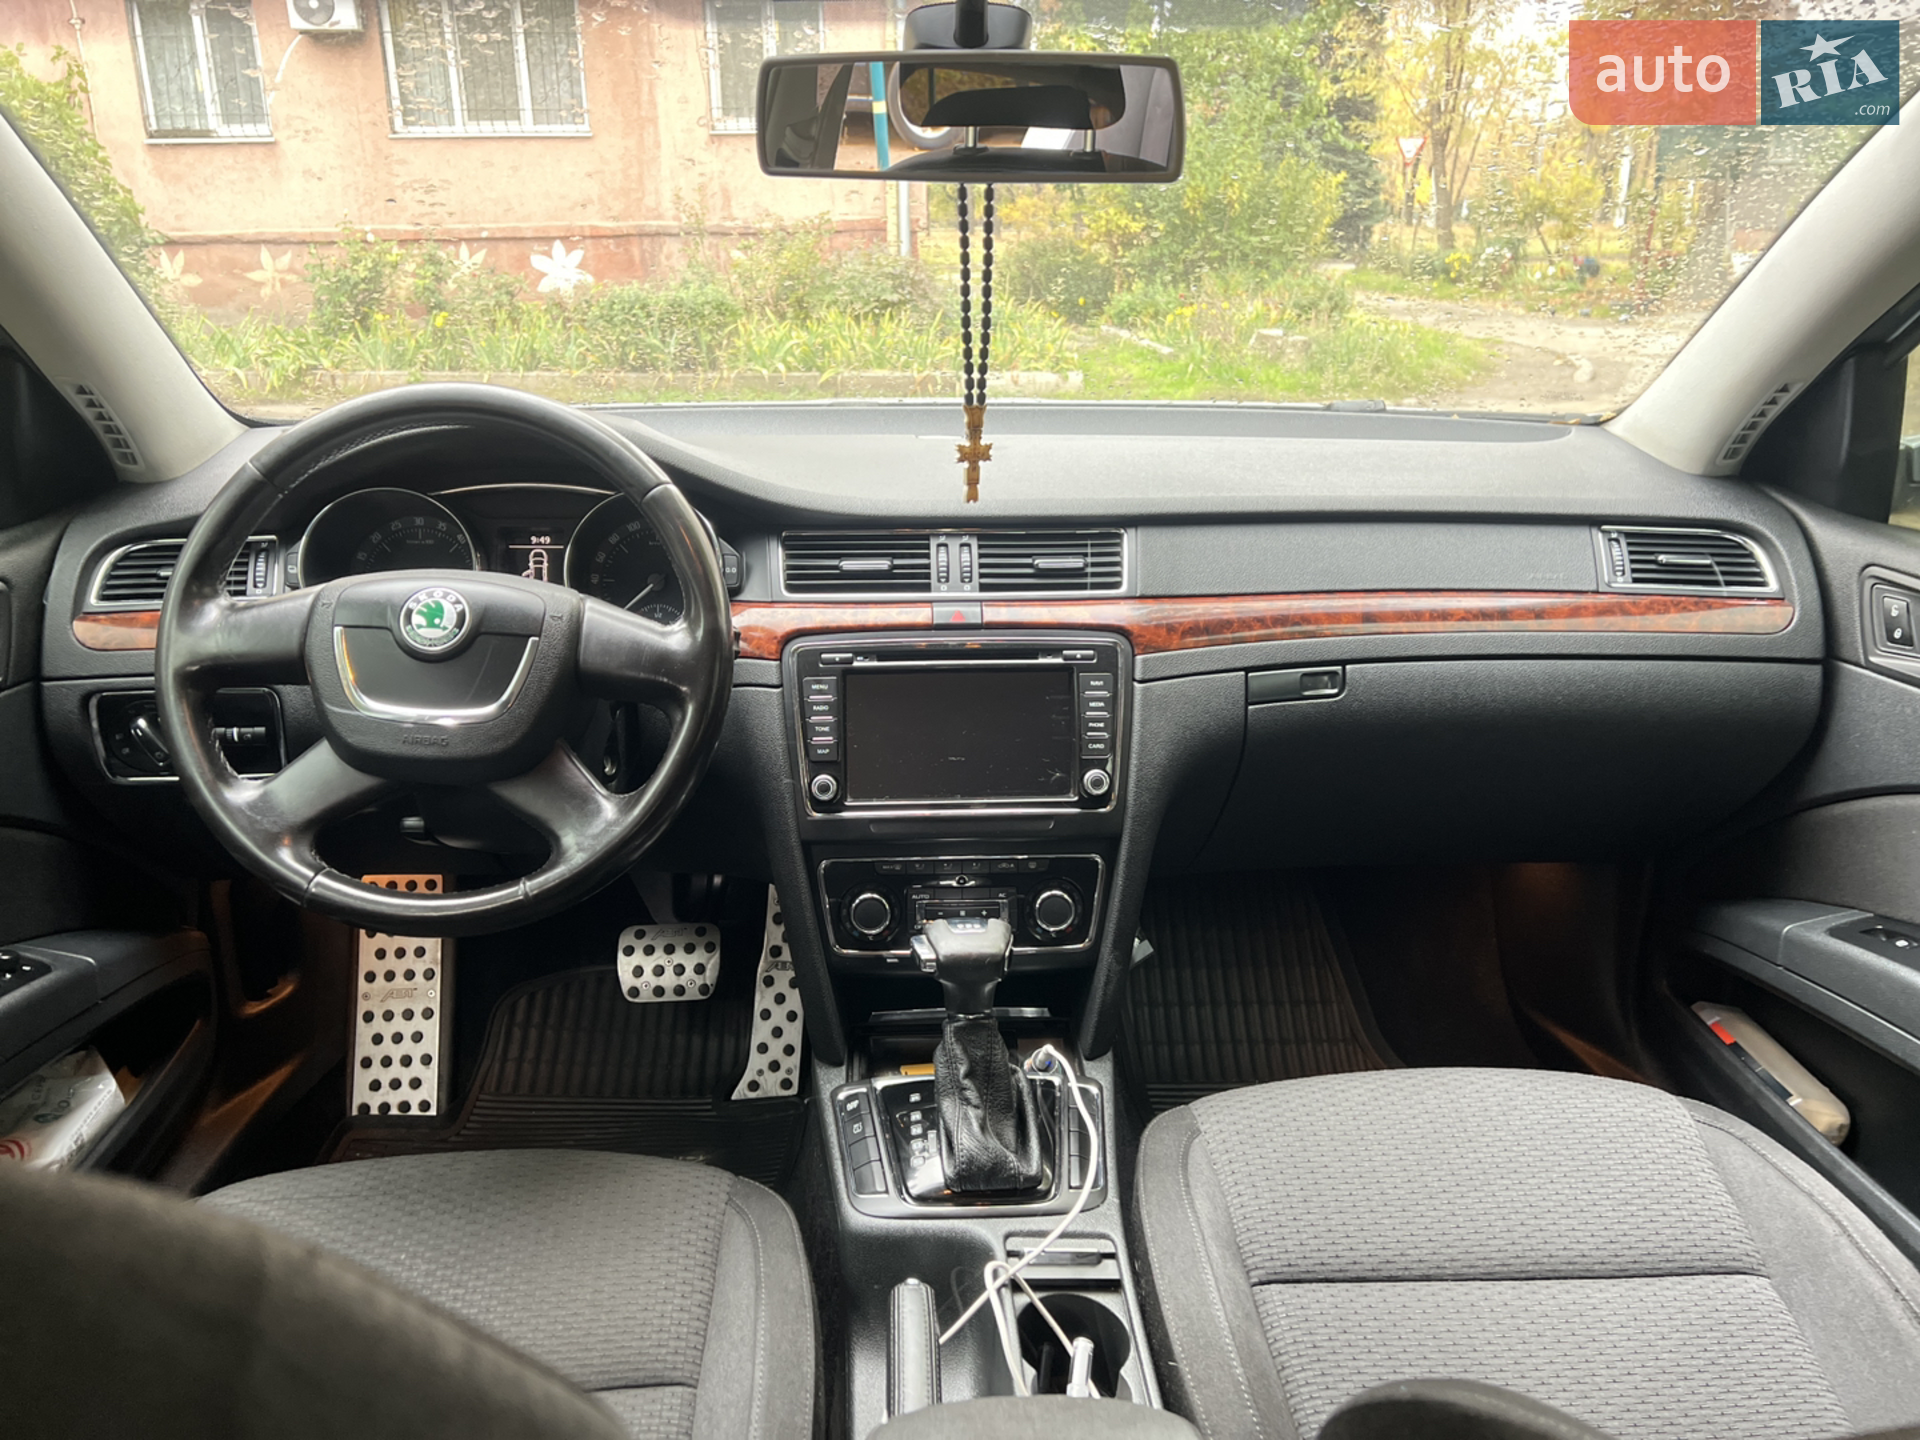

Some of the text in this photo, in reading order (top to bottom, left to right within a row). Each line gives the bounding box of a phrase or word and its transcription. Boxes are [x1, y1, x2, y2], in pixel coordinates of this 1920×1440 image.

[390, 520, 402, 531] 25
[413, 517, 424, 526] 30
[436, 521, 447, 532] 35
[626, 521, 641, 532] 100
[370, 531, 382, 543] 20
[456, 534, 466, 545] 40
[530, 535, 551, 545] 9:49
[608, 532, 620, 544] 80
[402, 734, 450, 747] AIRBAG
